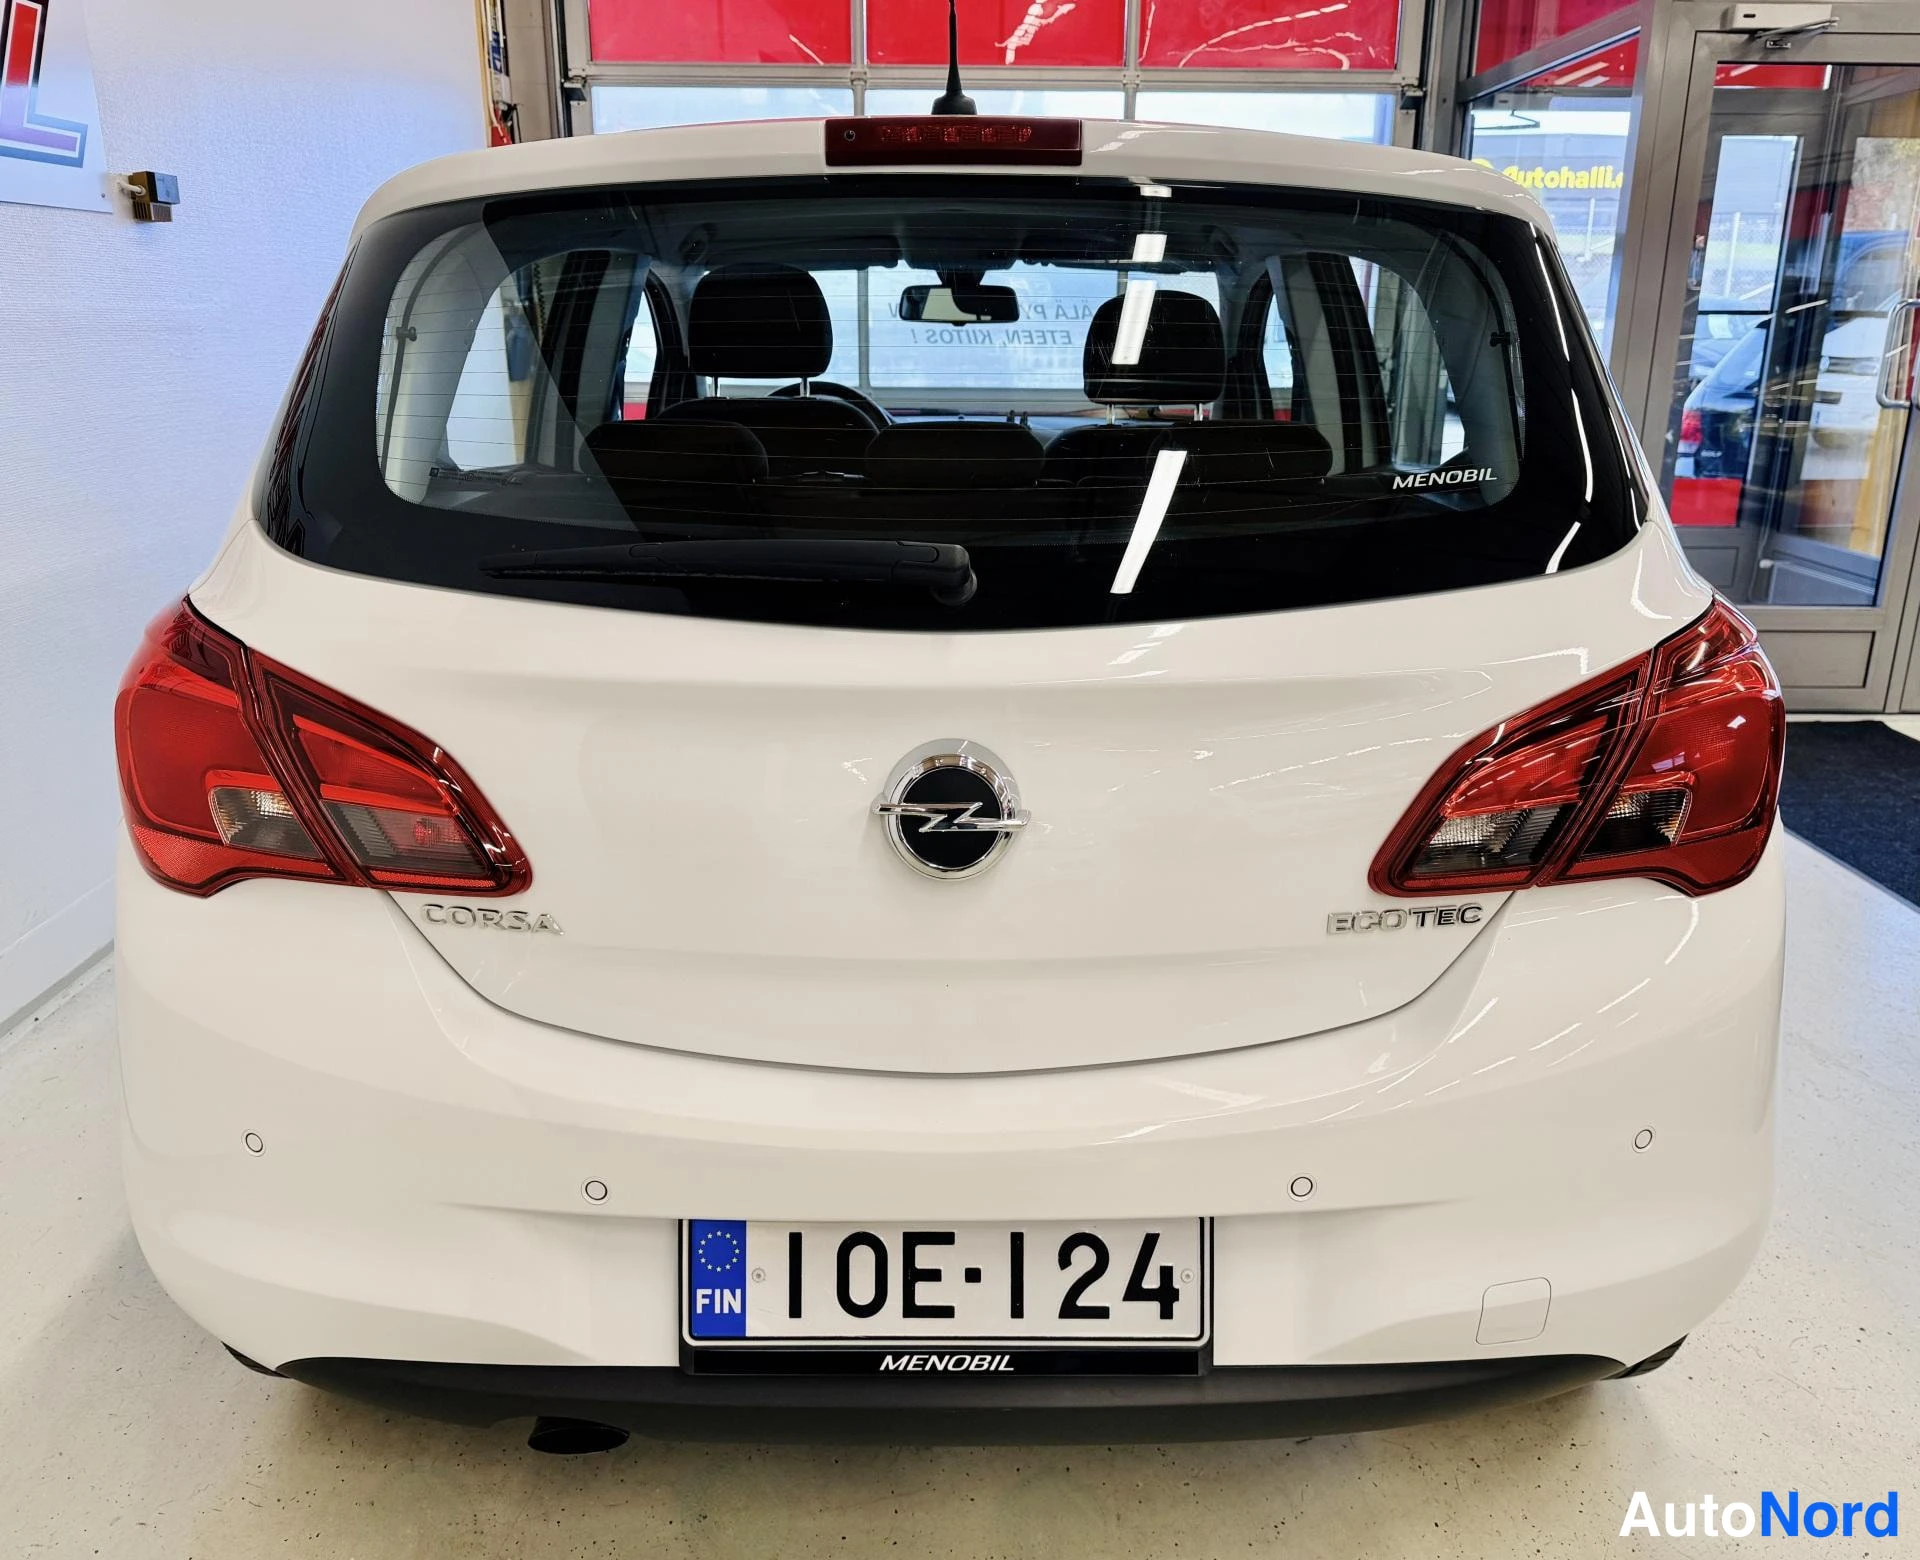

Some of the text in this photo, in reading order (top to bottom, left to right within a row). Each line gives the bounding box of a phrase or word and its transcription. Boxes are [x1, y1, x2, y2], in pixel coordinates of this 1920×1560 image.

[1392, 467, 1498, 490] MENOBIL
[421, 903, 565, 936] CORSA
[1327, 902, 1483, 935] ECOTEC
[695, 1288, 742, 1314] FIN
[879, 1354, 1015, 1372] MENOBIL
